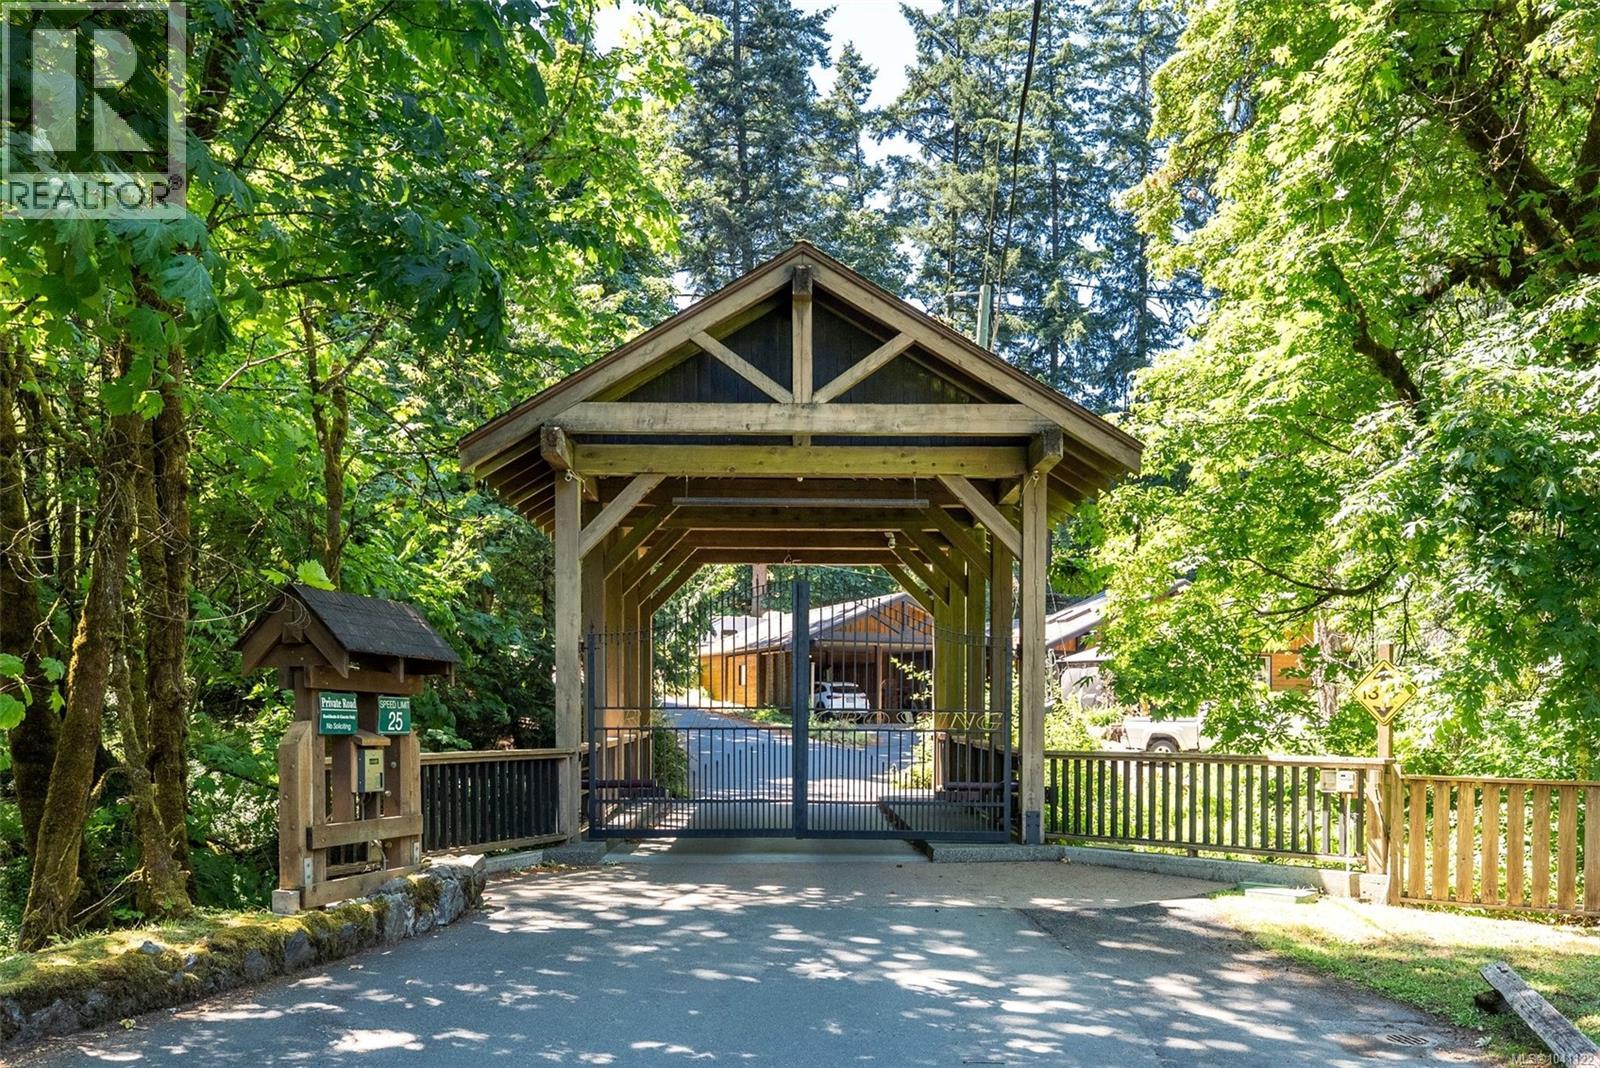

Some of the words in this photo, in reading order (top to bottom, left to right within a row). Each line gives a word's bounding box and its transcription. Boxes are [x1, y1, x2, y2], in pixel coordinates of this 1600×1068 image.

[321, 697, 342, 708] Private
[342, 698, 357, 709] Road
[379, 700, 397, 710] SPEED
[397, 701, 410, 710] LIMIT
[326, 722, 333, 730] No
[388, 711, 403, 731] 25
